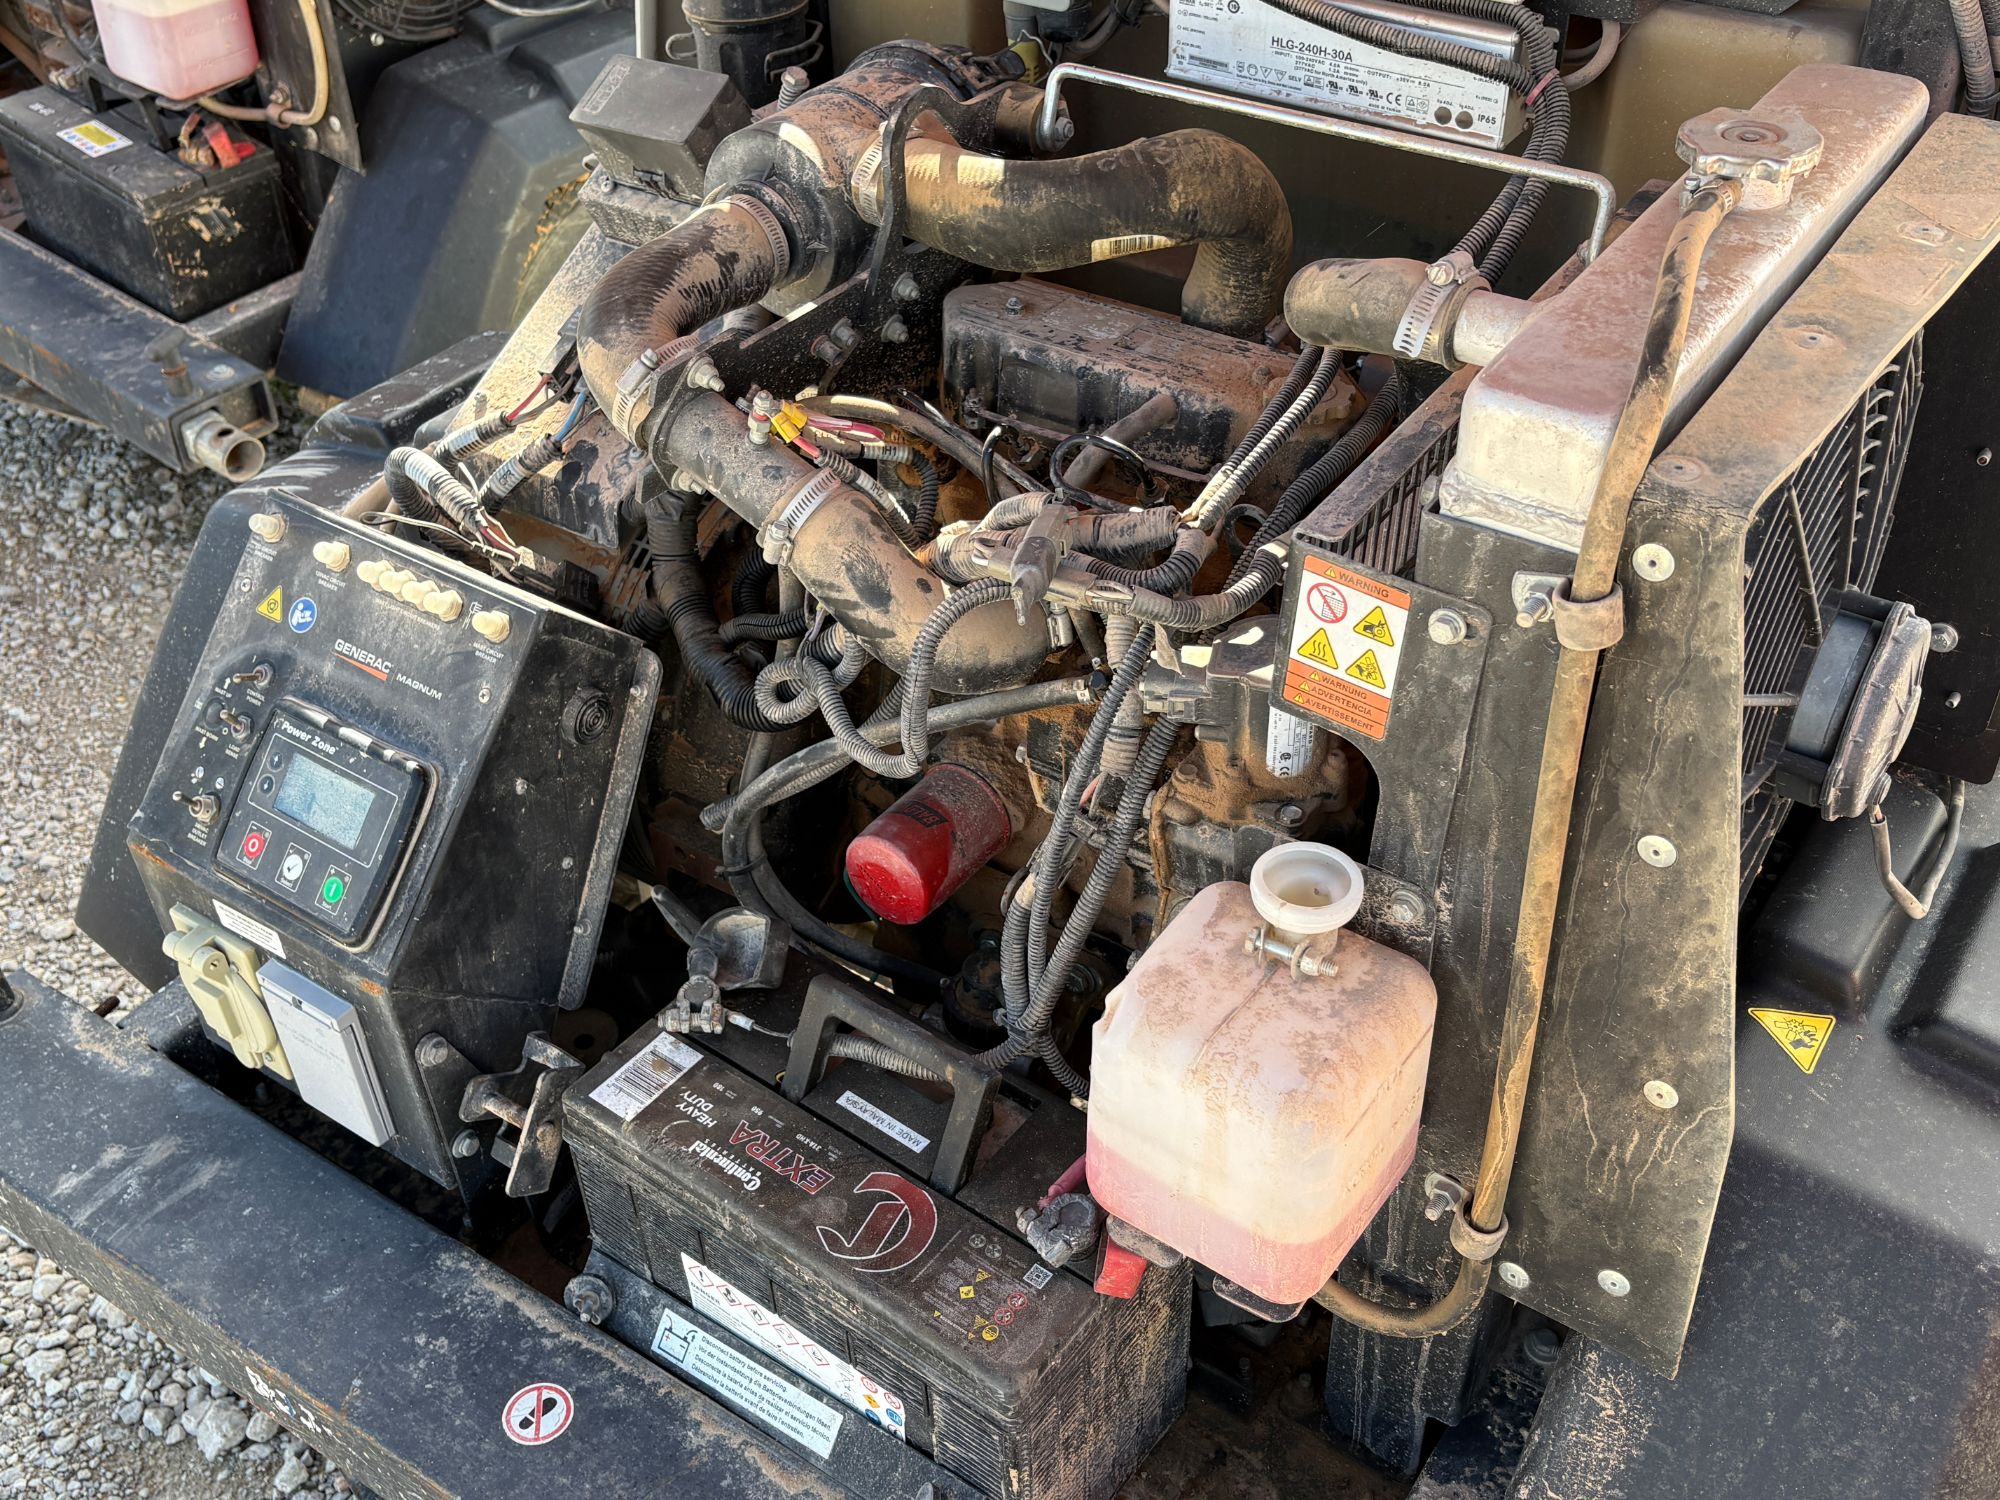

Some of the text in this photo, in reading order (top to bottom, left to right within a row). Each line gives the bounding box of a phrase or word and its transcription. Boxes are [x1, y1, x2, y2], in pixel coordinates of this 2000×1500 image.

[1271, 36, 1353, 62] HLG-240H-30A
[1477, 113, 1497, 125] IP65
[318, 579, 339, 592] BREAKER
[1338, 571, 1389, 600] WARNING
[334, 638, 393, 674] GENERAC
[475, 650, 497, 664] BREAKER
[484, 646, 504, 659] CIRCUIT
[246, 688, 266, 702] CONTROL
[396, 673, 443, 700] MAGNUM
[1321, 674, 1368, 701] WARNUNG
[246, 695, 262, 707] POWER
[1304, 697, 1375, 732] AVERTISSEMENT
[1310, 685, 1373, 717] ADVERTENCIA
[228, 743, 241, 753] LOAD
[281, 721, 336, 755] Power Zone
[679, 1089, 714, 1112] DUTY
[845, 1096, 886, 1125] MALAYSIA
[675, 1102, 718, 1128] HEAVY
[896, 1128, 922, 1147] MADE
[688, 1140, 762, 1192] Continental
[703, 1137, 762, 1178] BATTERIES
[729, 1119, 836, 1195] EXTRA
[701, 1335, 788, 1393] Disconnect battery before servicing.
[707, 1350, 716, 1359] der
[694, 1353, 722, 1373] Desconecte
[743, 1384, 758, 1397] antes
[765, 1396, 785, 1414] realizar
[790, 1411, 811, 1430] servicio
[725, 1384, 744, 1401] batterie
[744, 1397, 759, 1409] avant
[766, 1409, 778, 1421] faire
